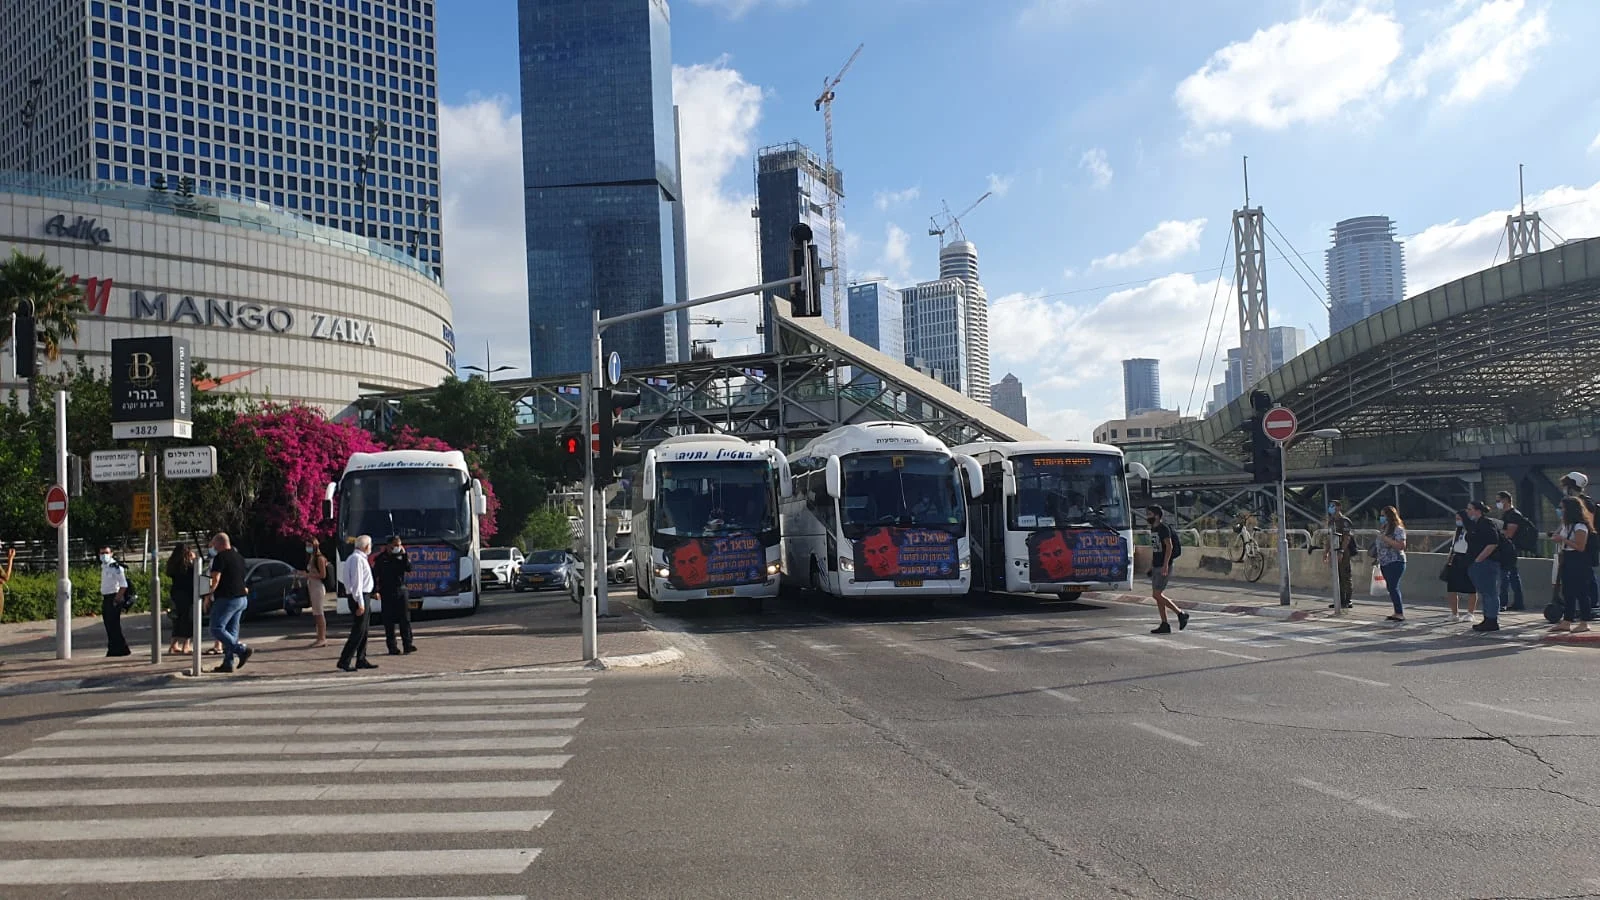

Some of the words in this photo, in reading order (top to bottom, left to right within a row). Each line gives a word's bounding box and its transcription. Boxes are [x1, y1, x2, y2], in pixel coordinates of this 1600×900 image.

[45, 214, 112, 245] Adika
[130, 290, 295, 333] MANGO
[311, 312, 377, 347] ZARA
[130, 352, 154, 380] B
[128, 389, 158, 400] בהרי
[167, 451, 195, 459] השלום
[678, 451, 709, 460] נתניה
[716, 448, 753, 460] המטייל
[922, 532, 949, 543] ישראל
[1095, 535, 1120, 546] ישראל
[731, 539, 757, 550] ישראל
[422, 549, 451, 561] ישראל
